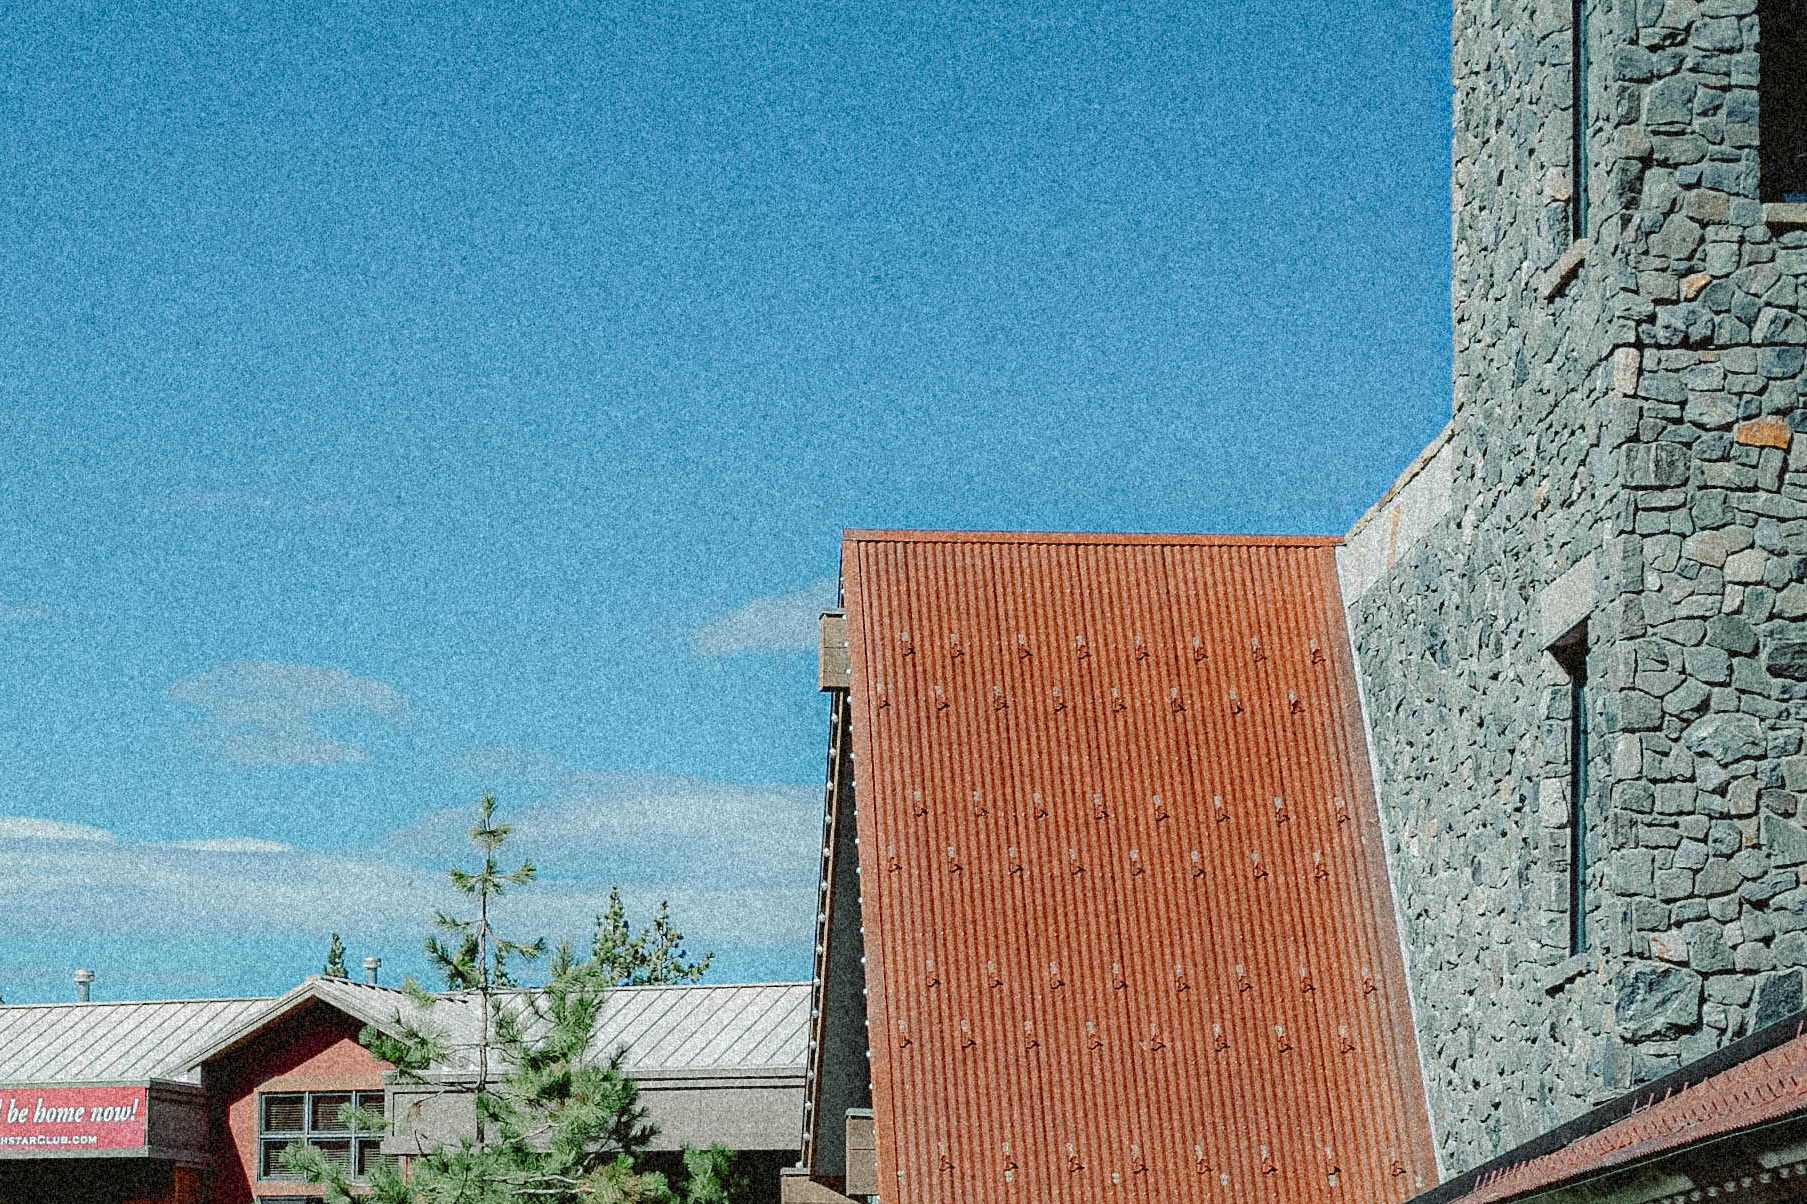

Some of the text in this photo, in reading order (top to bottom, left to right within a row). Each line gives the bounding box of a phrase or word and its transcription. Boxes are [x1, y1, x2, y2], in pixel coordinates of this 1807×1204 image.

[6, 1098, 33, 1123] be
[33, 1098, 85, 1123] home
[90, 1098, 140, 1122] now!
